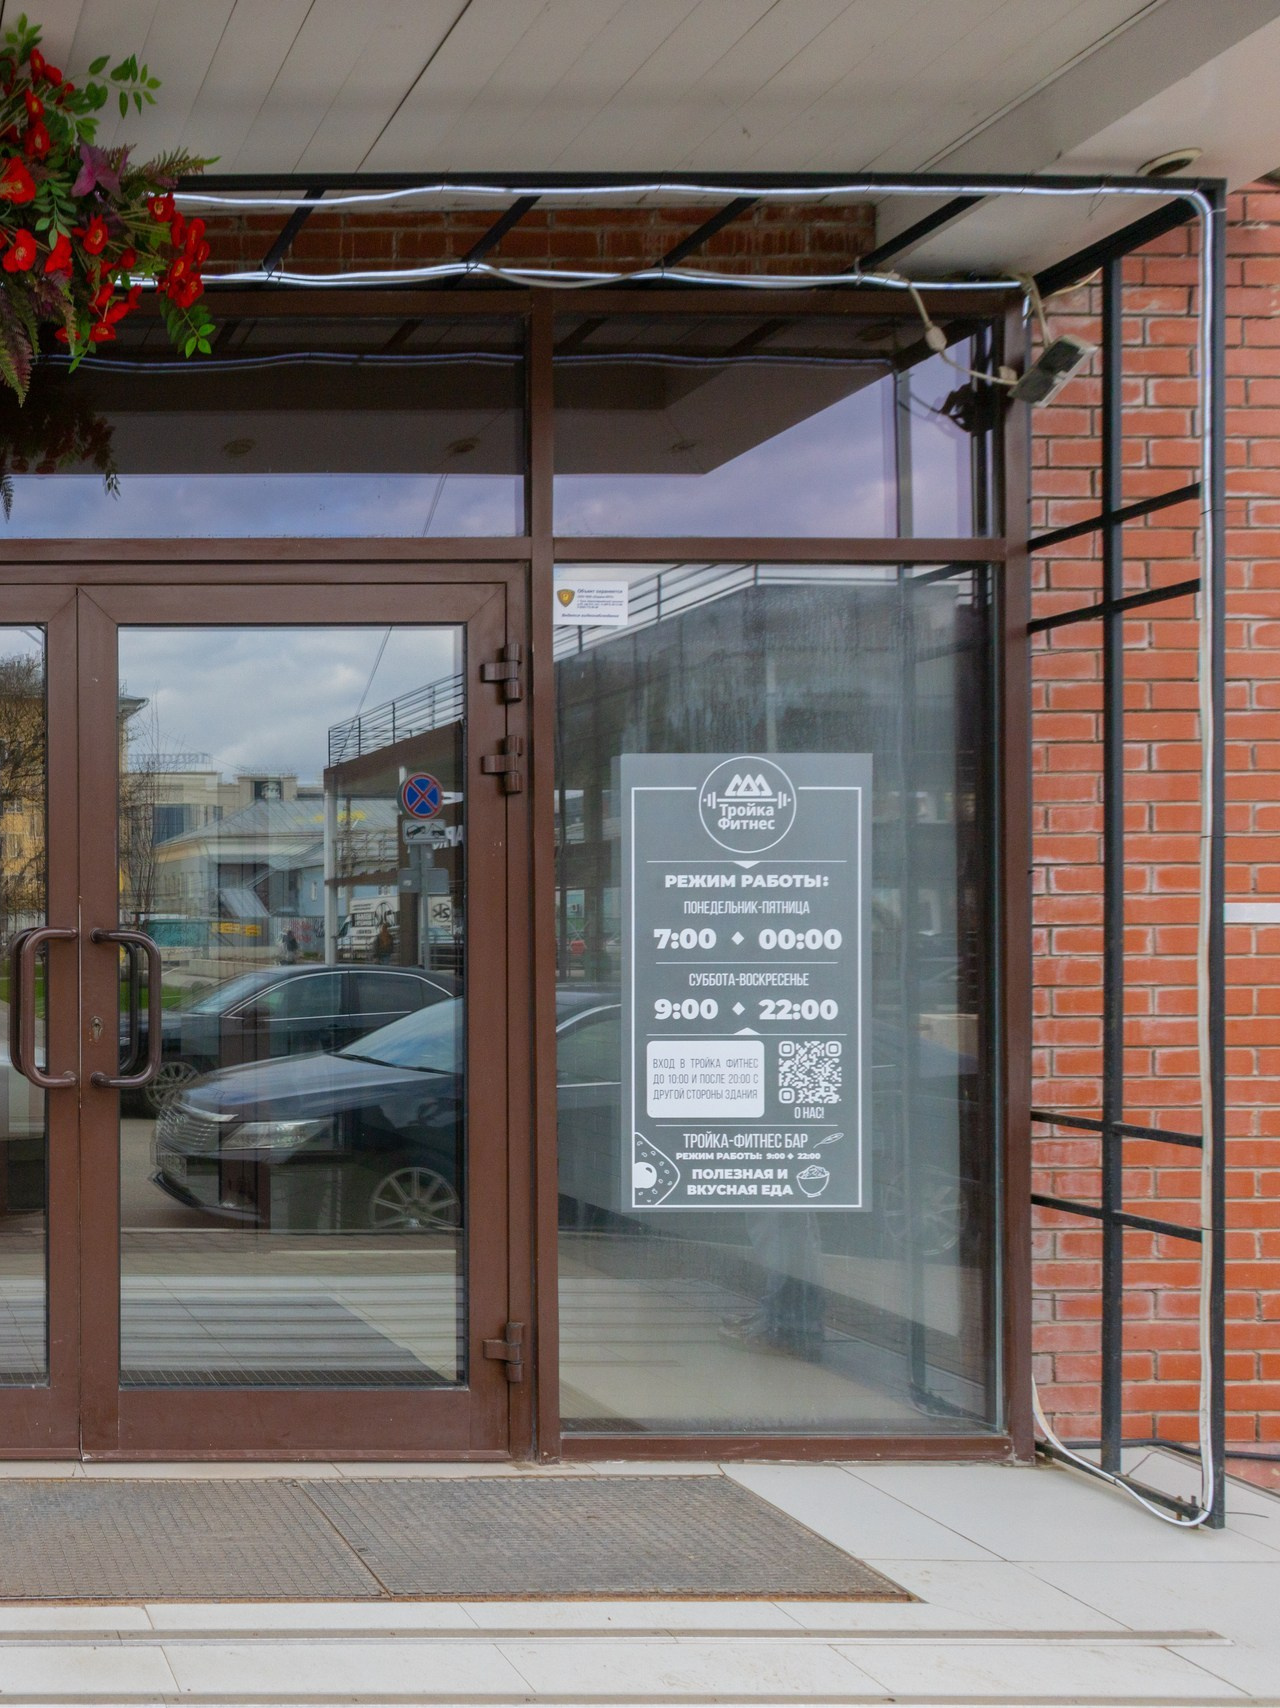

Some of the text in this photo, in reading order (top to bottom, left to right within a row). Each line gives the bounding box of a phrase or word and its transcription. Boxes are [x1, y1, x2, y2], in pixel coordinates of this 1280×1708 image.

[719, 802, 774, 819] Тройка
[718, 817, 775, 830] Фитнес
[665, 875, 828, 887] РЕЖИМ РАБОТЫ:
[684, 901, 810, 915] ПОНЕДЕЛЬНИК-ПЯТНИЦА
[654, 928, 842, 950] 7:00 00:00
[689, 973, 809, 986] СУББОТА-ВОСКРЕСЕНЬЕ
[654, 999, 838, 1020] 9:00 22:00
[653, 1057, 758, 1069] ВХОД В ТРОЙКА ФИТНЕС
[653, 1074, 758, 1085] ДО 10:00 И ПОСЛЕ 20:00 С
[653, 1088, 757, 1100] ДРУГОЙ СТОРОНЫ ЗДАНИЯ
[794, 1107, 824, 1118] О НАС!
[683, 1131, 808, 1148] ТРОЙКА-ФИТНЕС БАР
[692, 1169, 788, 1179] ПОЛЕЗНАЯ И
[687, 1185, 793, 1196] ВКУСНАЯ ЕДА
